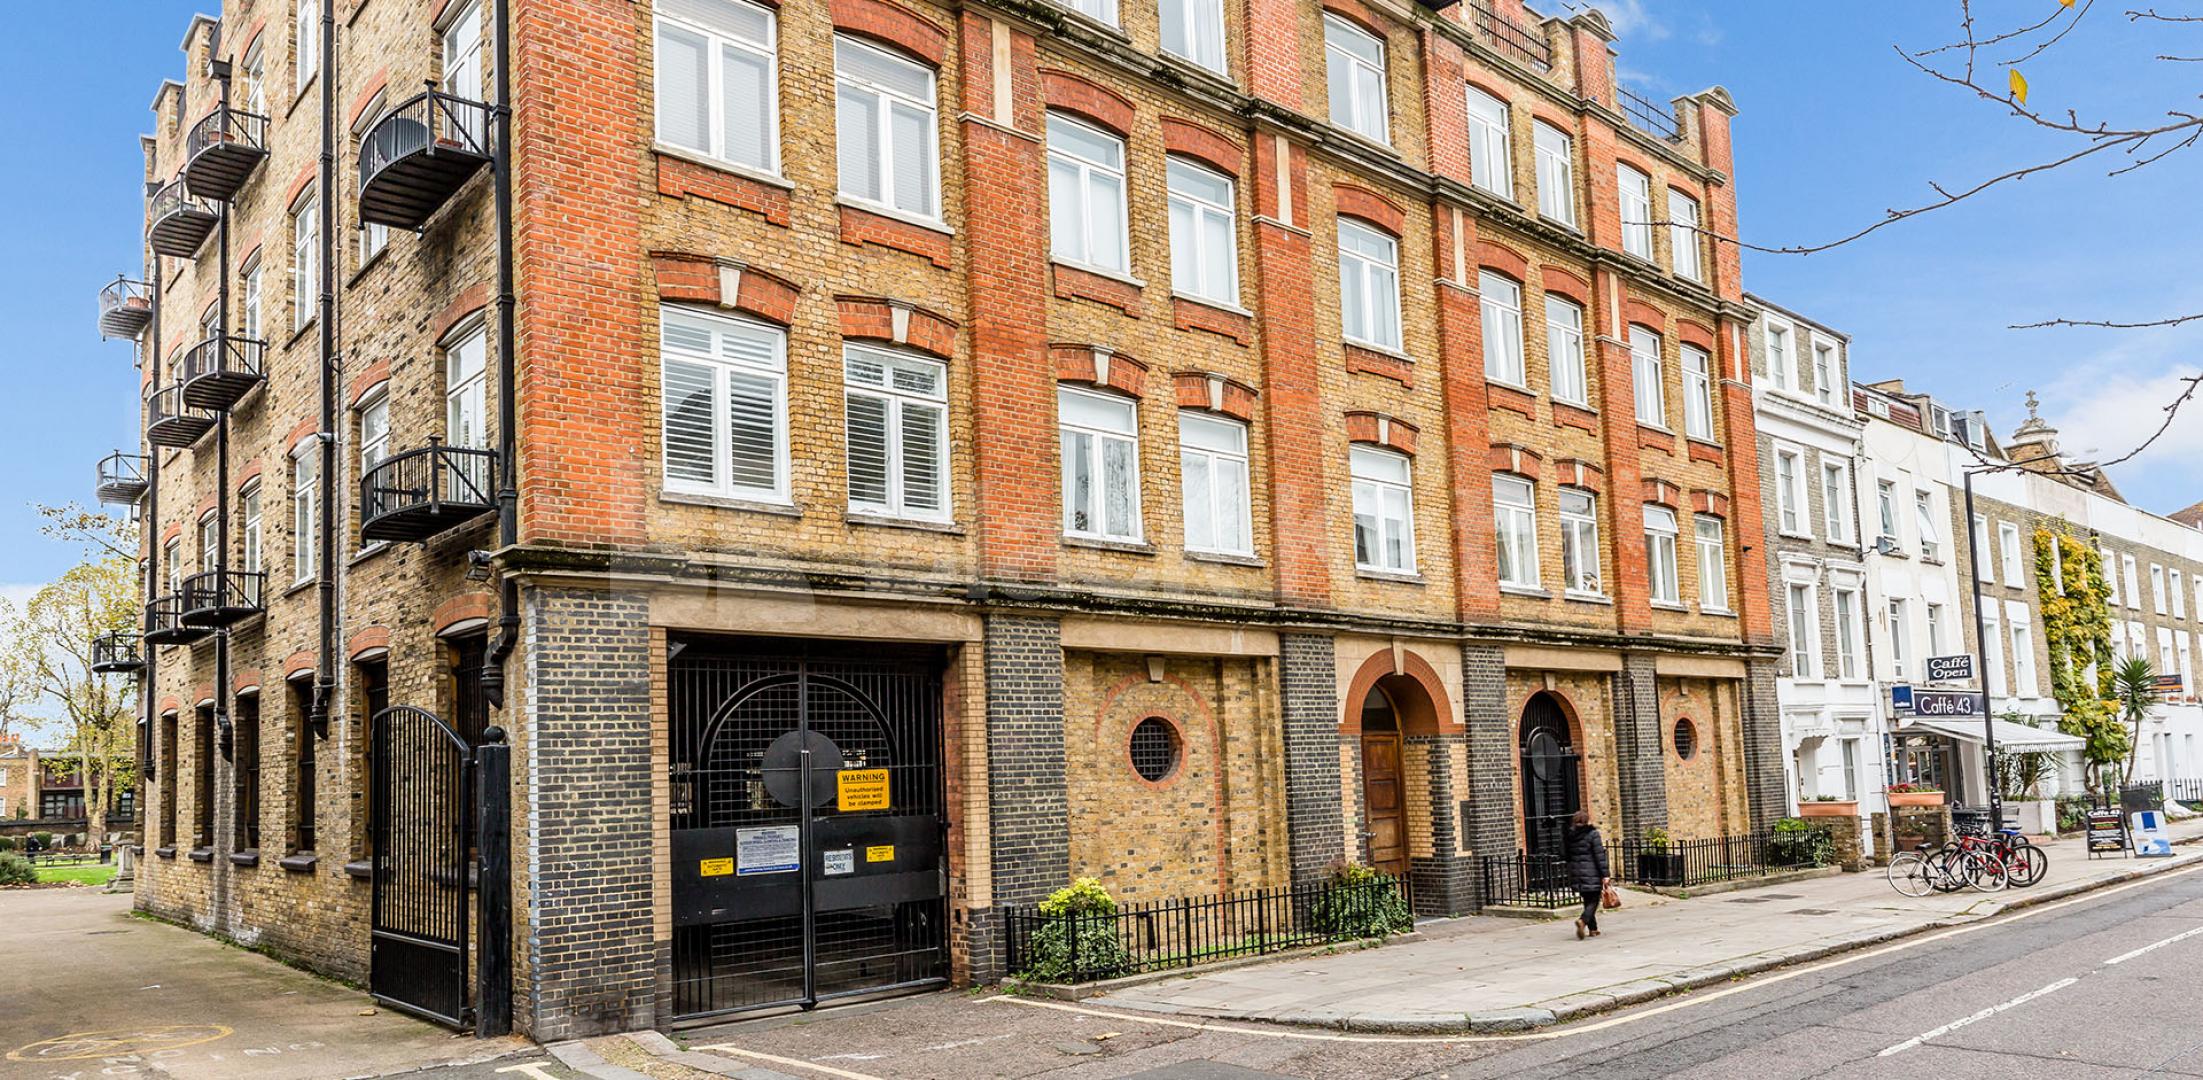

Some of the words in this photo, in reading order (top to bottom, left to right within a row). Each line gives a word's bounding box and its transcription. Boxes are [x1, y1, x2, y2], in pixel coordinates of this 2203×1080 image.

[1931, 657, 1969, 669] Caffé
[1933, 669, 1968, 679] Open
[1921, 697, 1954, 714] Caffé
[1956, 697, 1971, 713] 43
[842, 773, 885, 781] WARNING
